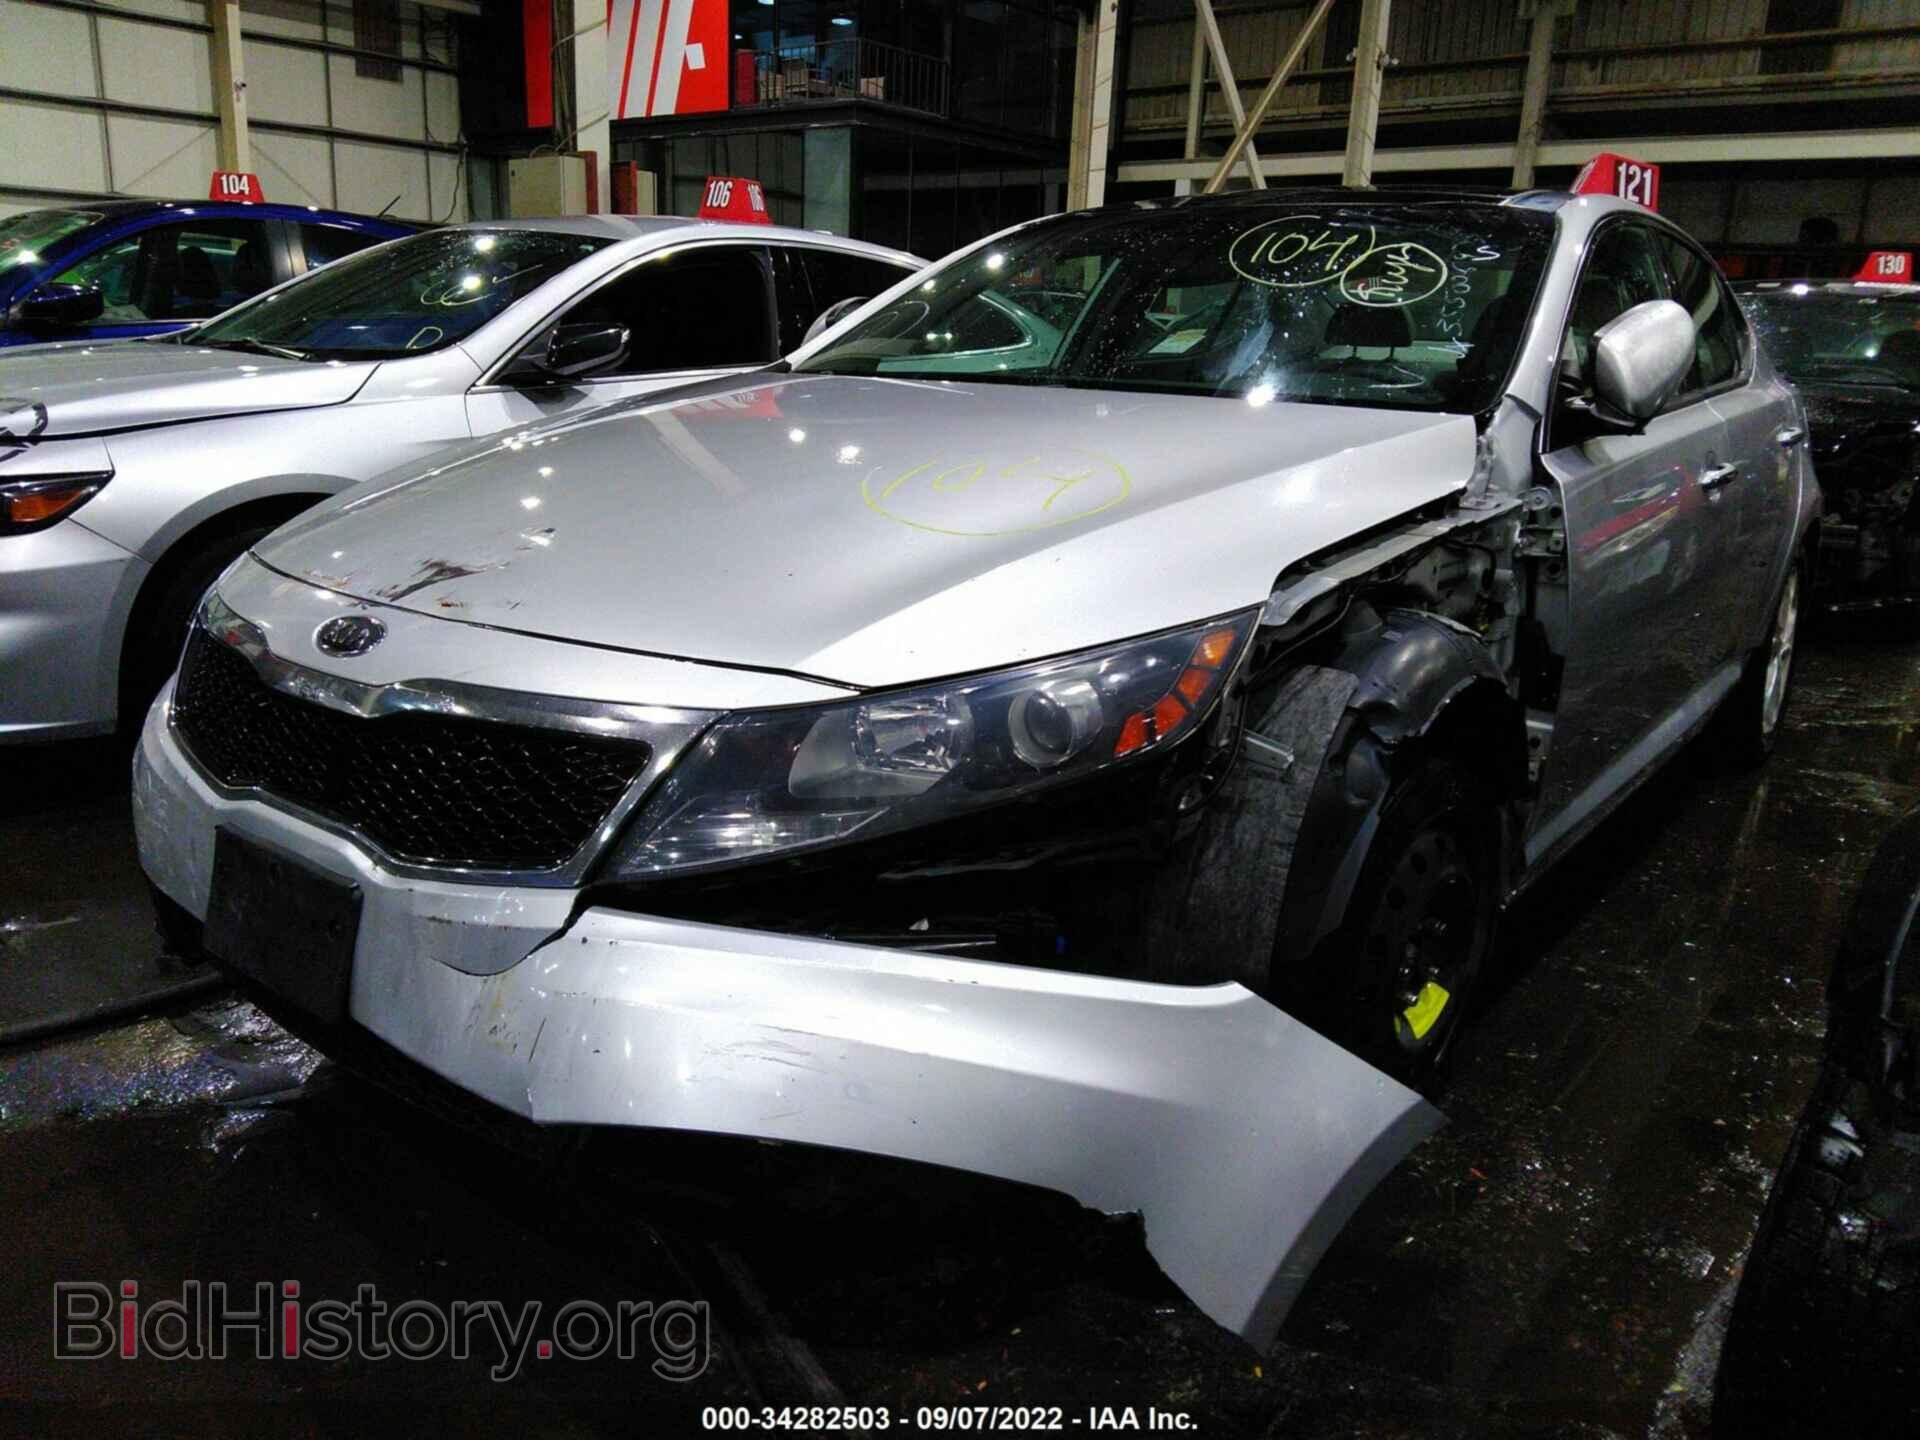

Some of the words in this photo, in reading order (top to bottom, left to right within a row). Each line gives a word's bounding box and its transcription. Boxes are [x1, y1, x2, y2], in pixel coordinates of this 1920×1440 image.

[220, 174, 249, 195] 104
[706, 180, 733, 208] 106
[1617, 161, 1652, 206] 121
[1250, 230, 1360, 272] 104
[1878, 255, 1905, 275] 130
